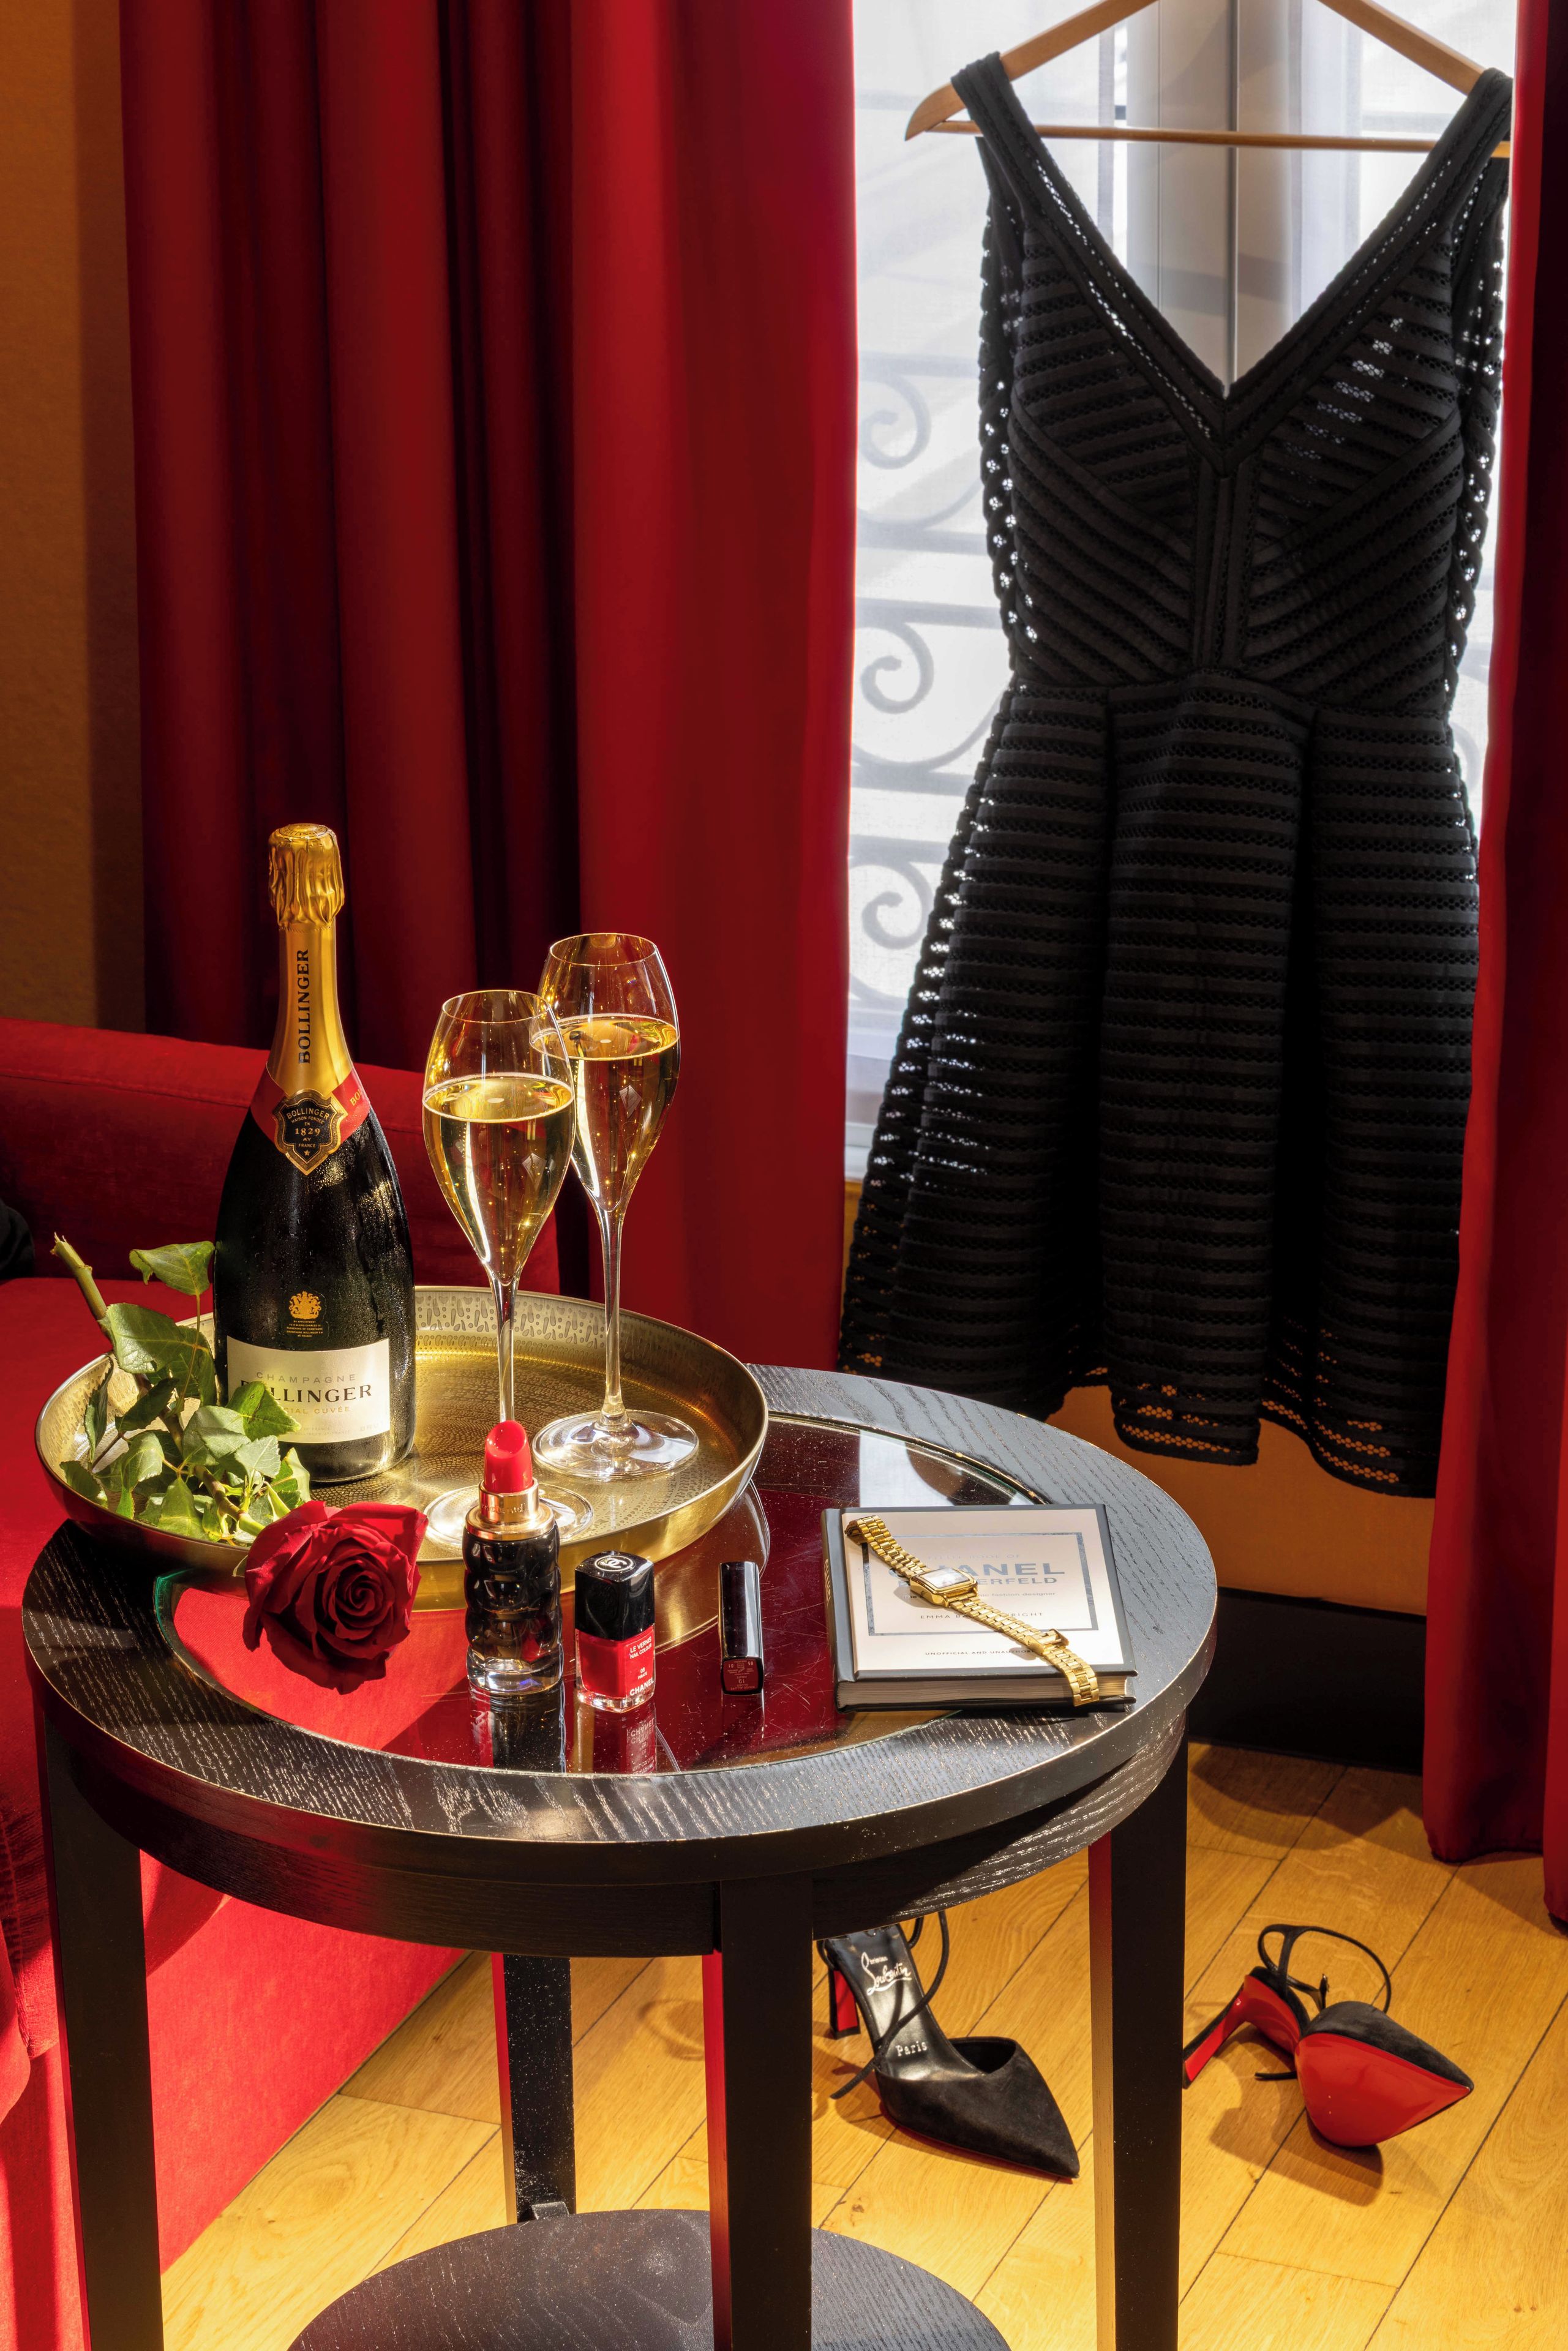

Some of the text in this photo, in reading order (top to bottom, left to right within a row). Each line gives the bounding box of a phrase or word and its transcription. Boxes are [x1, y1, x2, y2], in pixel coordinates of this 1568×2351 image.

[296, 949, 310, 1064] BOLLINGER
[286, 1108, 329, 1120] BOLLINGER
[295, 1128, 320, 1136] 1829
[257, 1372, 356, 1384] CHAMPAGNE
[241, 1380, 372, 1403] LLINGER
[314, 1406, 350, 1414] CUVÉE
[978, 1577, 1057, 1587] ERFELD
[637, 1636, 651, 1649] VERNIS
[639, 1643, 651, 1655] COLOUR
[629, 1677, 654, 1696] CHANEL
[896, 2041, 928, 2057] Paris
